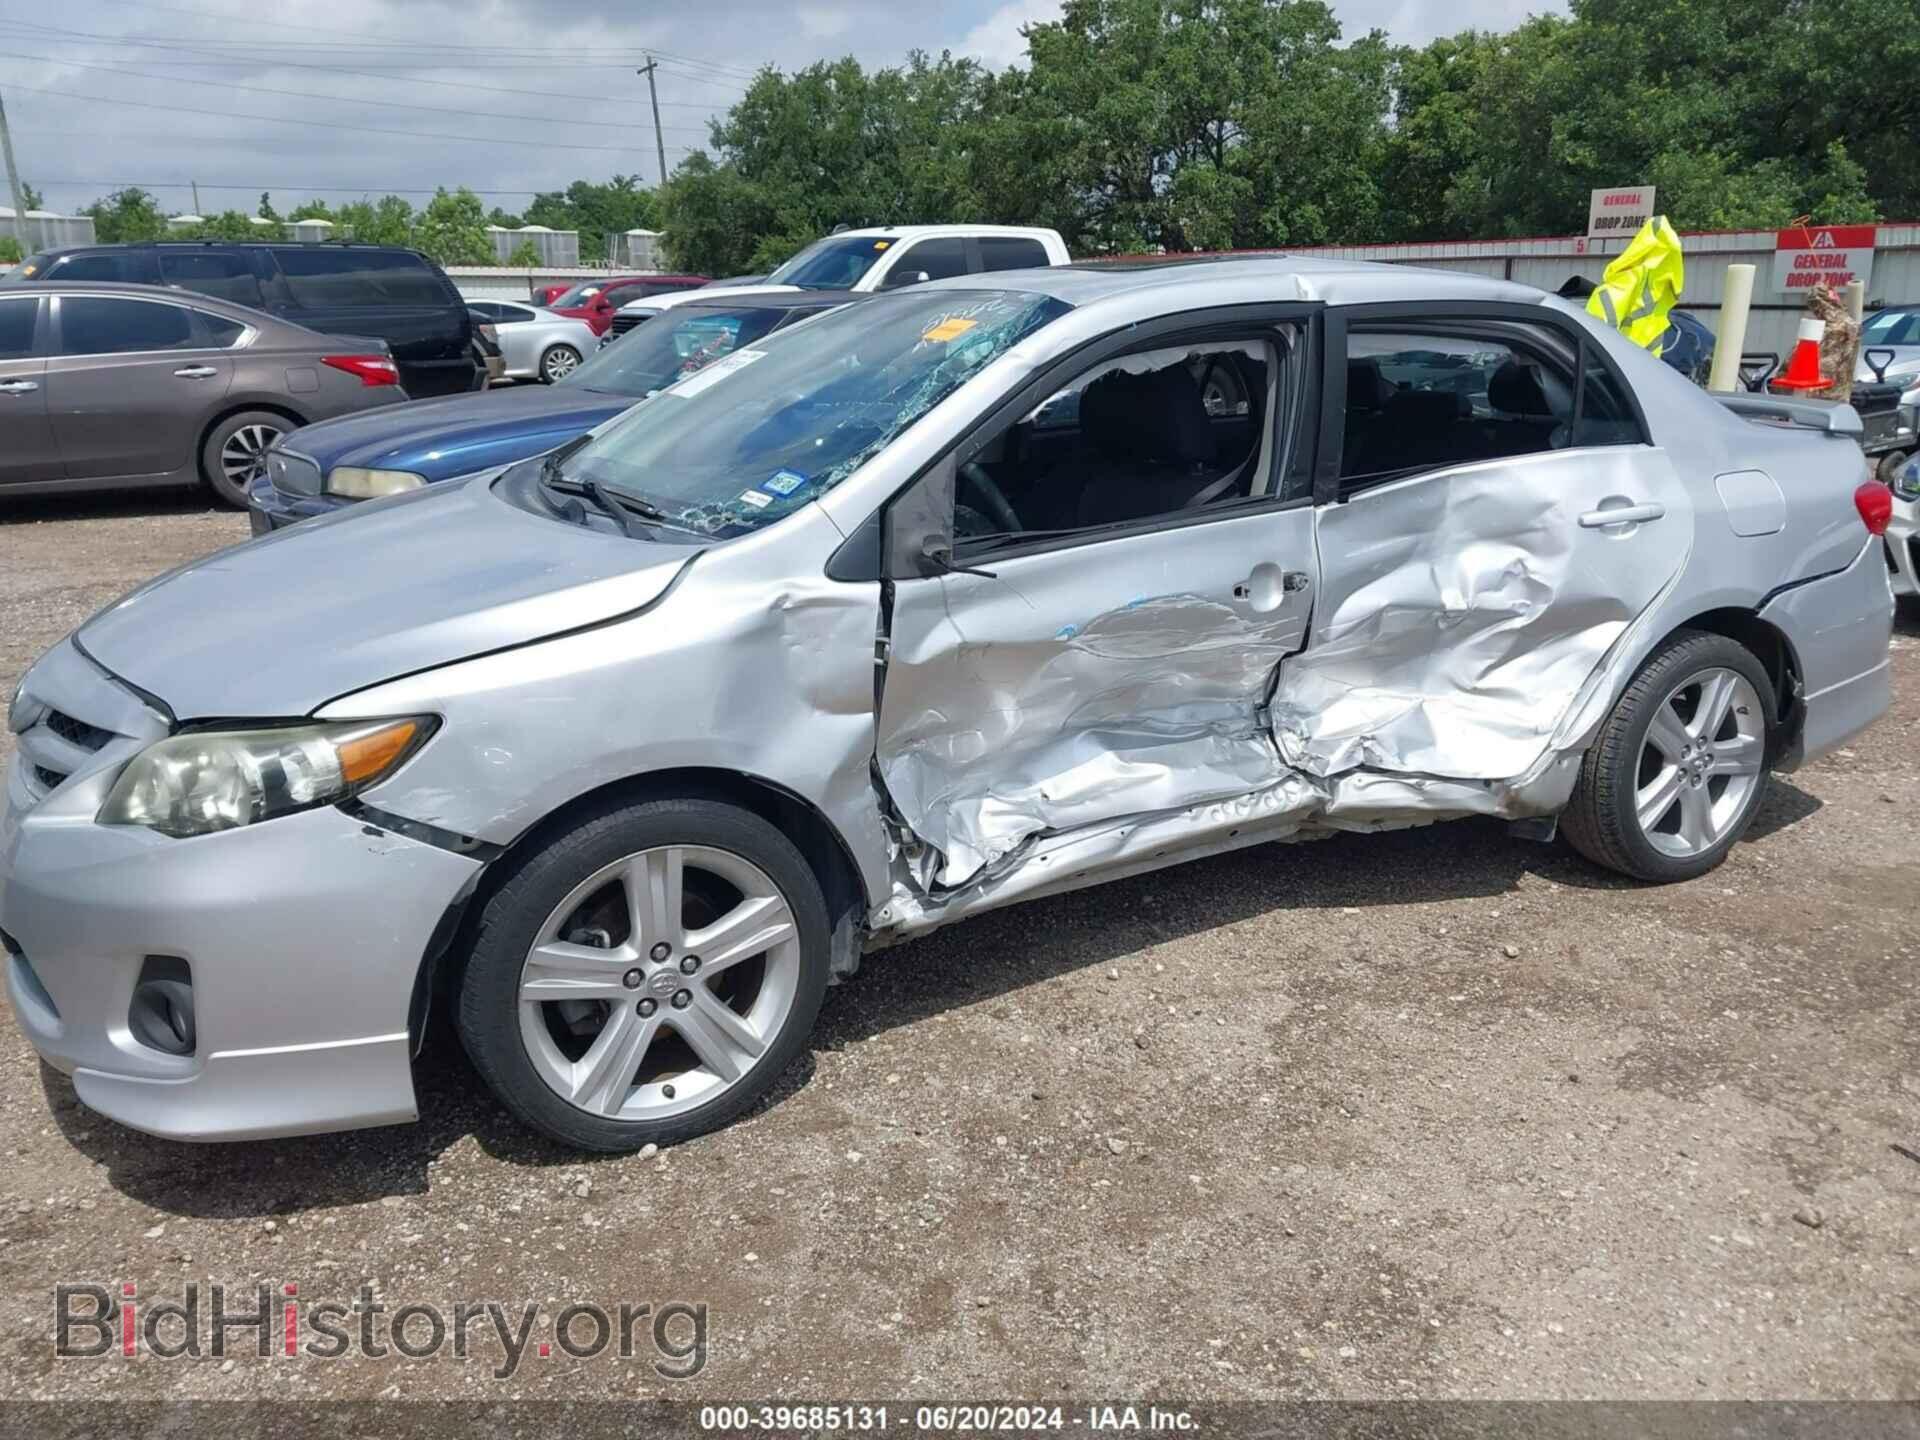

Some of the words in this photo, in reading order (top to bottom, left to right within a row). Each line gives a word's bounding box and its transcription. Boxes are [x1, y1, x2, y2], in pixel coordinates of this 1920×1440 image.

[1603, 193, 1642, 207] GENERAL
[1594, 217, 1621, 230] DROP
[1621, 216, 1647, 229] ZONE
[1793, 254, 1848, 269] GENERAL
[1785, 272, 1822, 287] DROP
